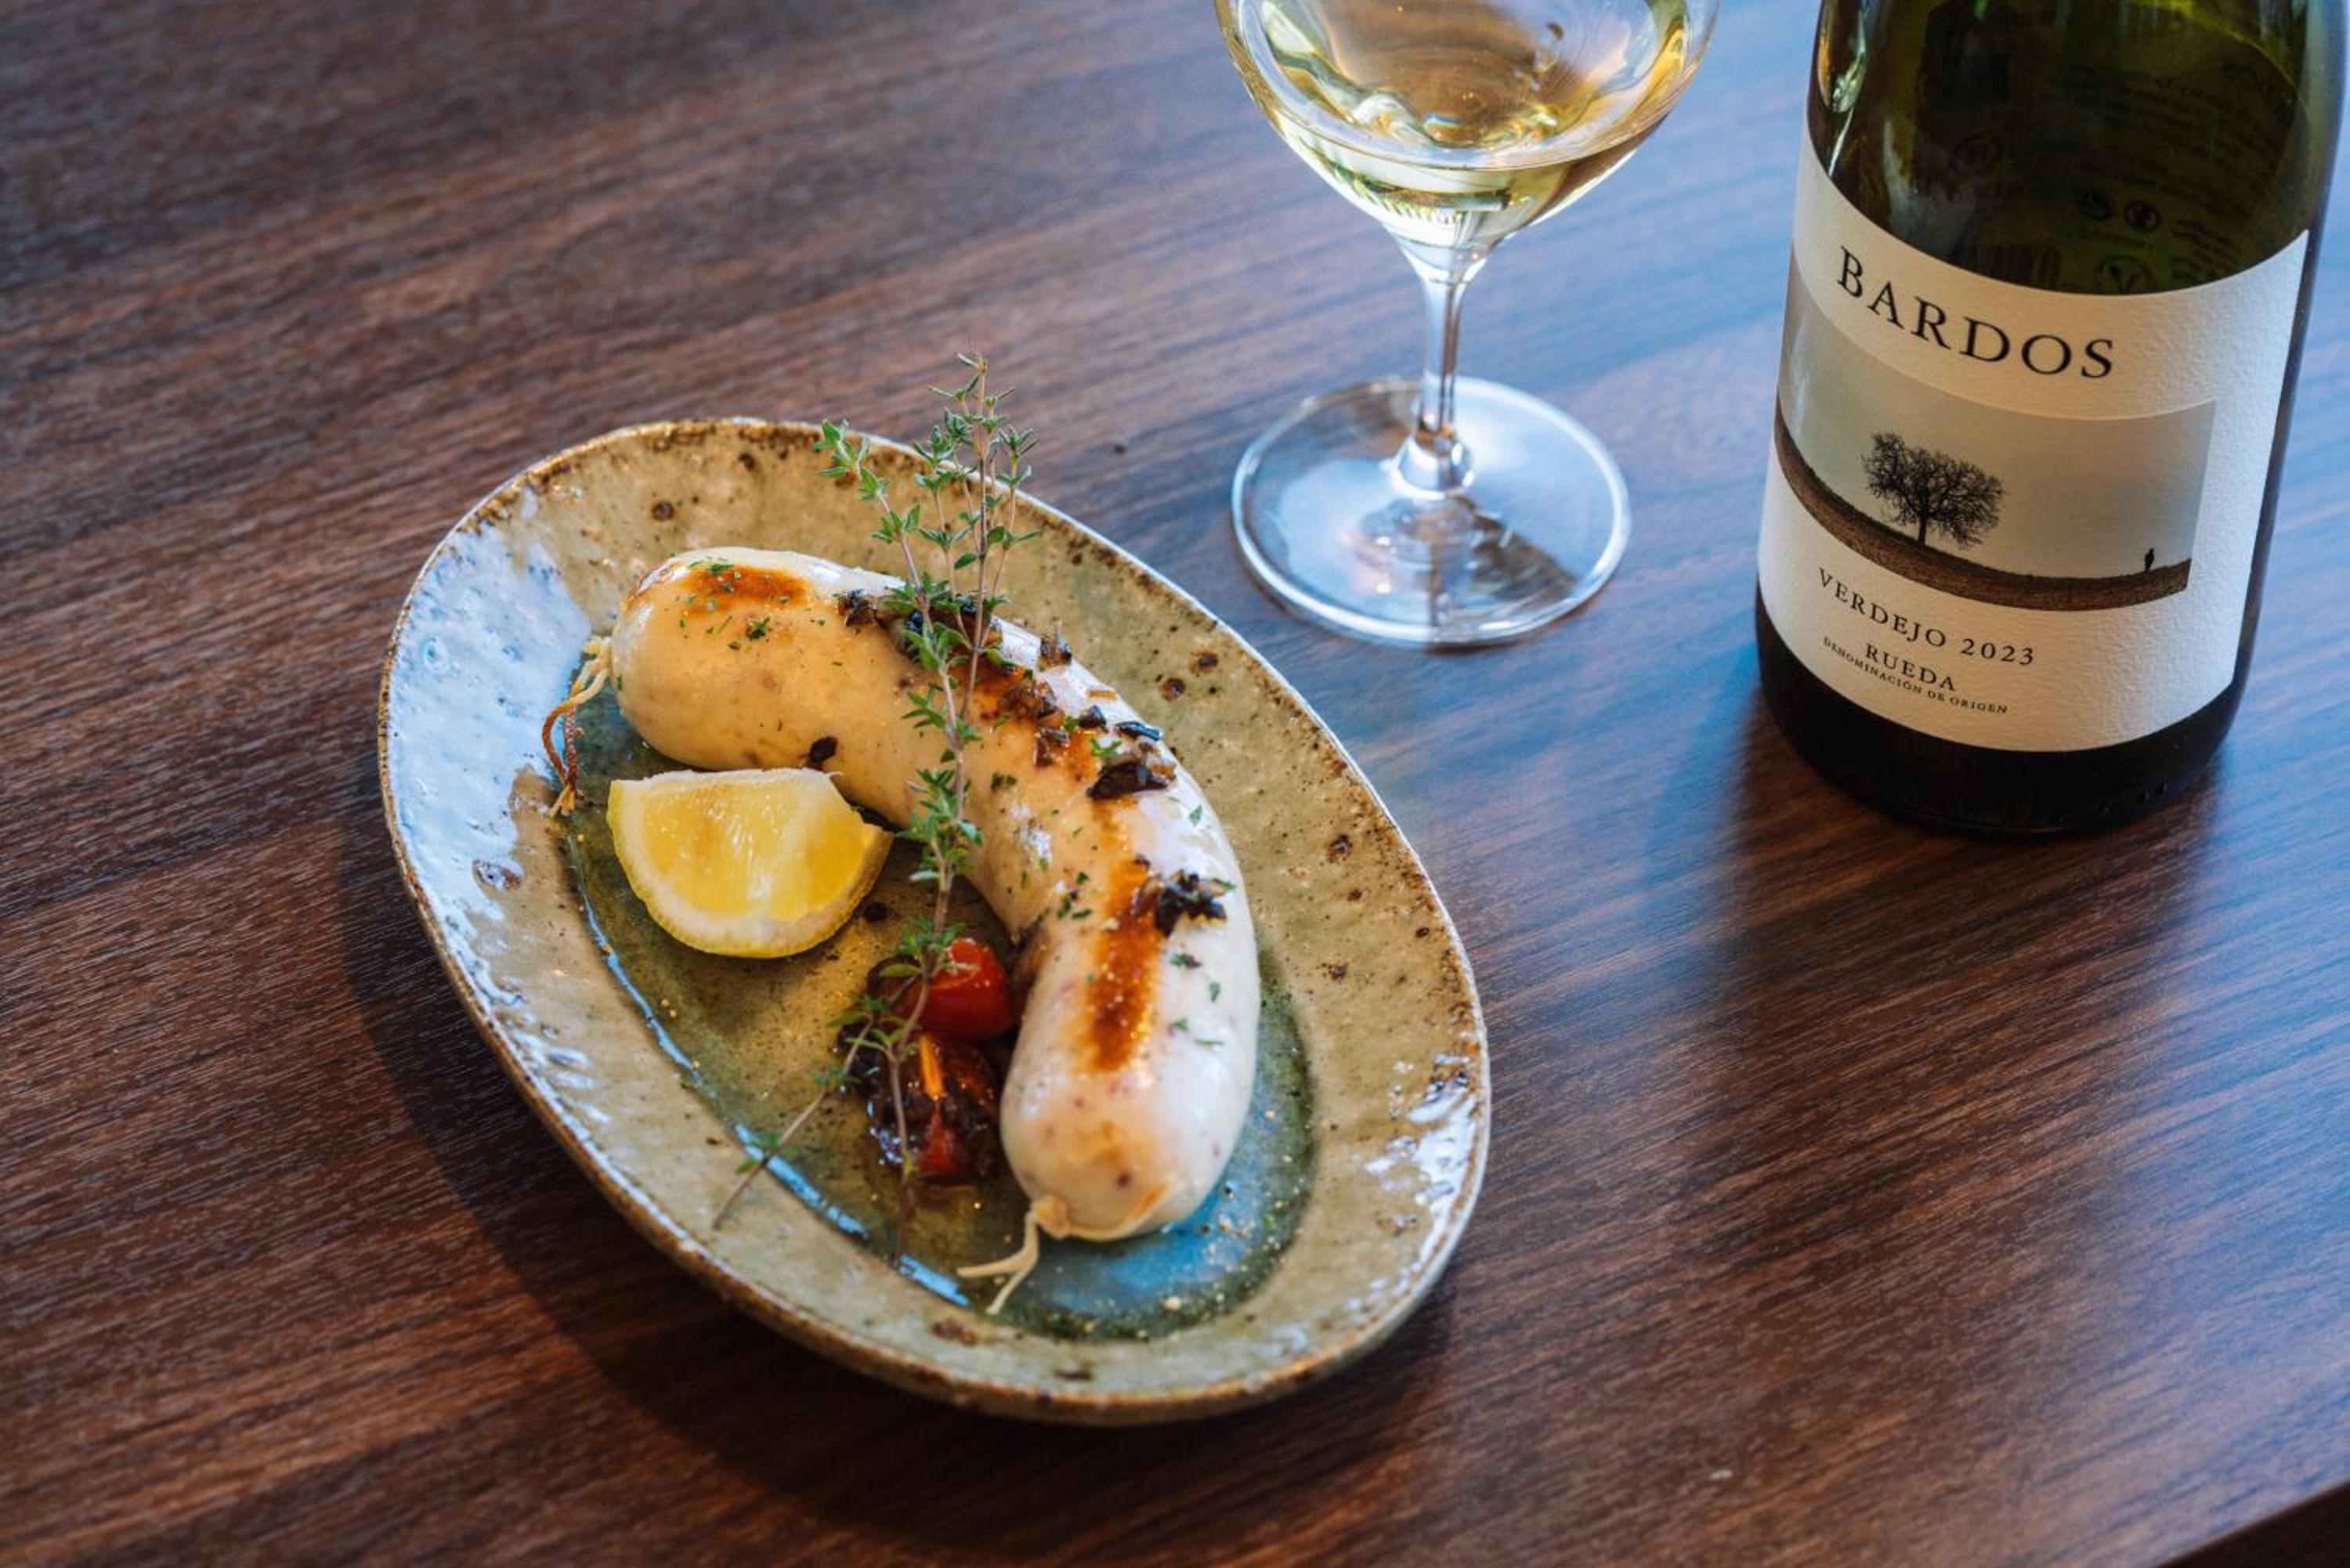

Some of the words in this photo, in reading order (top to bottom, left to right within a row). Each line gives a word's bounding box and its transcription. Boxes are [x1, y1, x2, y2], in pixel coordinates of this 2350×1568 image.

[1837, 245, 2114, 379] BARDOS
[1819, 567, 1947, 648] VERDEJO
[1961, 638, 2034, 665] 2023
[1865, 642, 1956, 692] RUEDA
[1927, 689, 1945, 703] DE
[1950, 695, 2008, 714] ORIGEN
